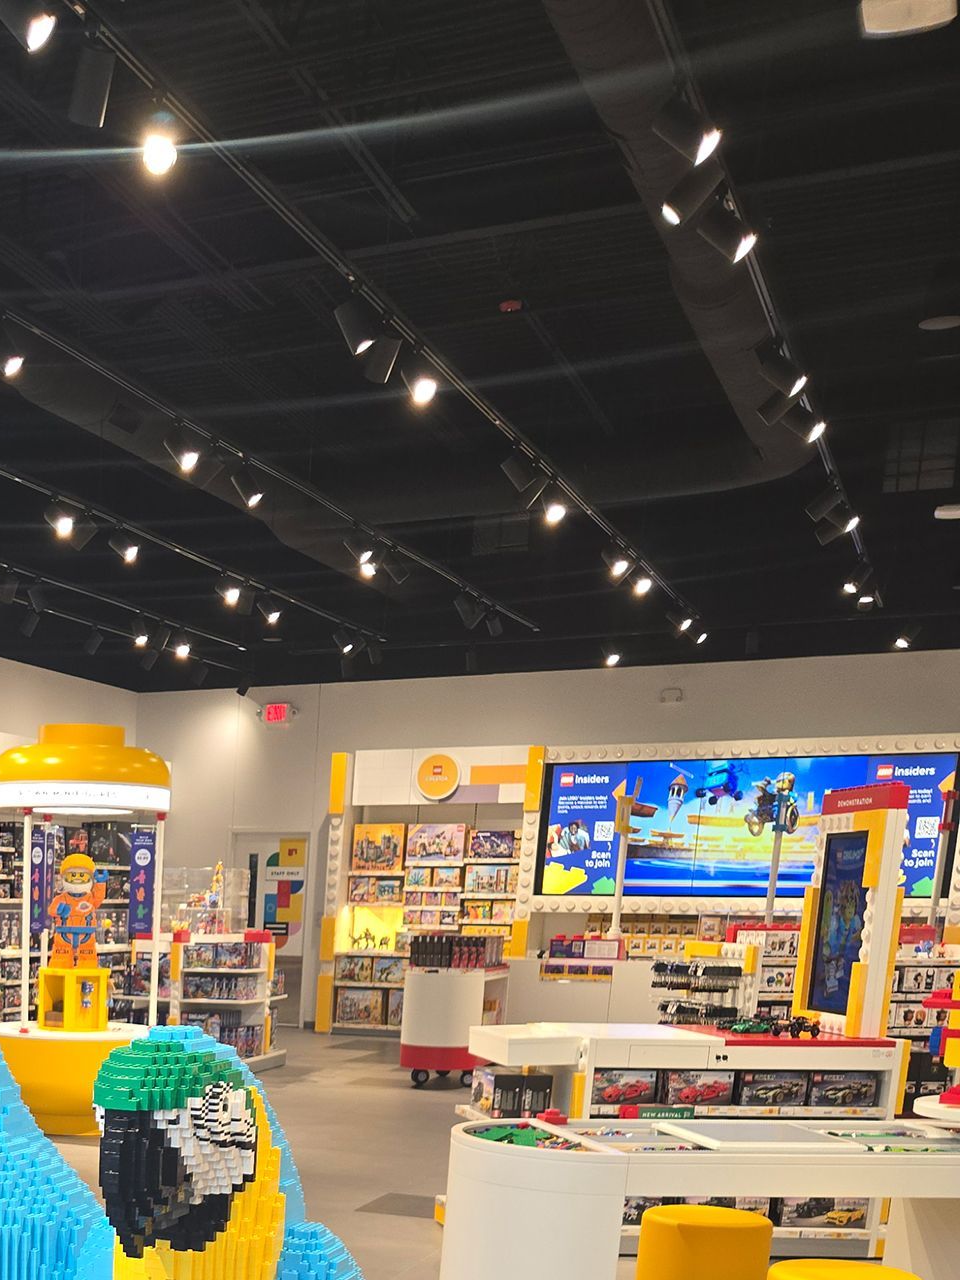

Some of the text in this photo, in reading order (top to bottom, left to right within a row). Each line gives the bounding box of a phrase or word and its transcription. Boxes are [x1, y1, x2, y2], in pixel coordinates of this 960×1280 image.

[911, 849, 935, 858] Scan
[904, 858, 934, 869] to join
